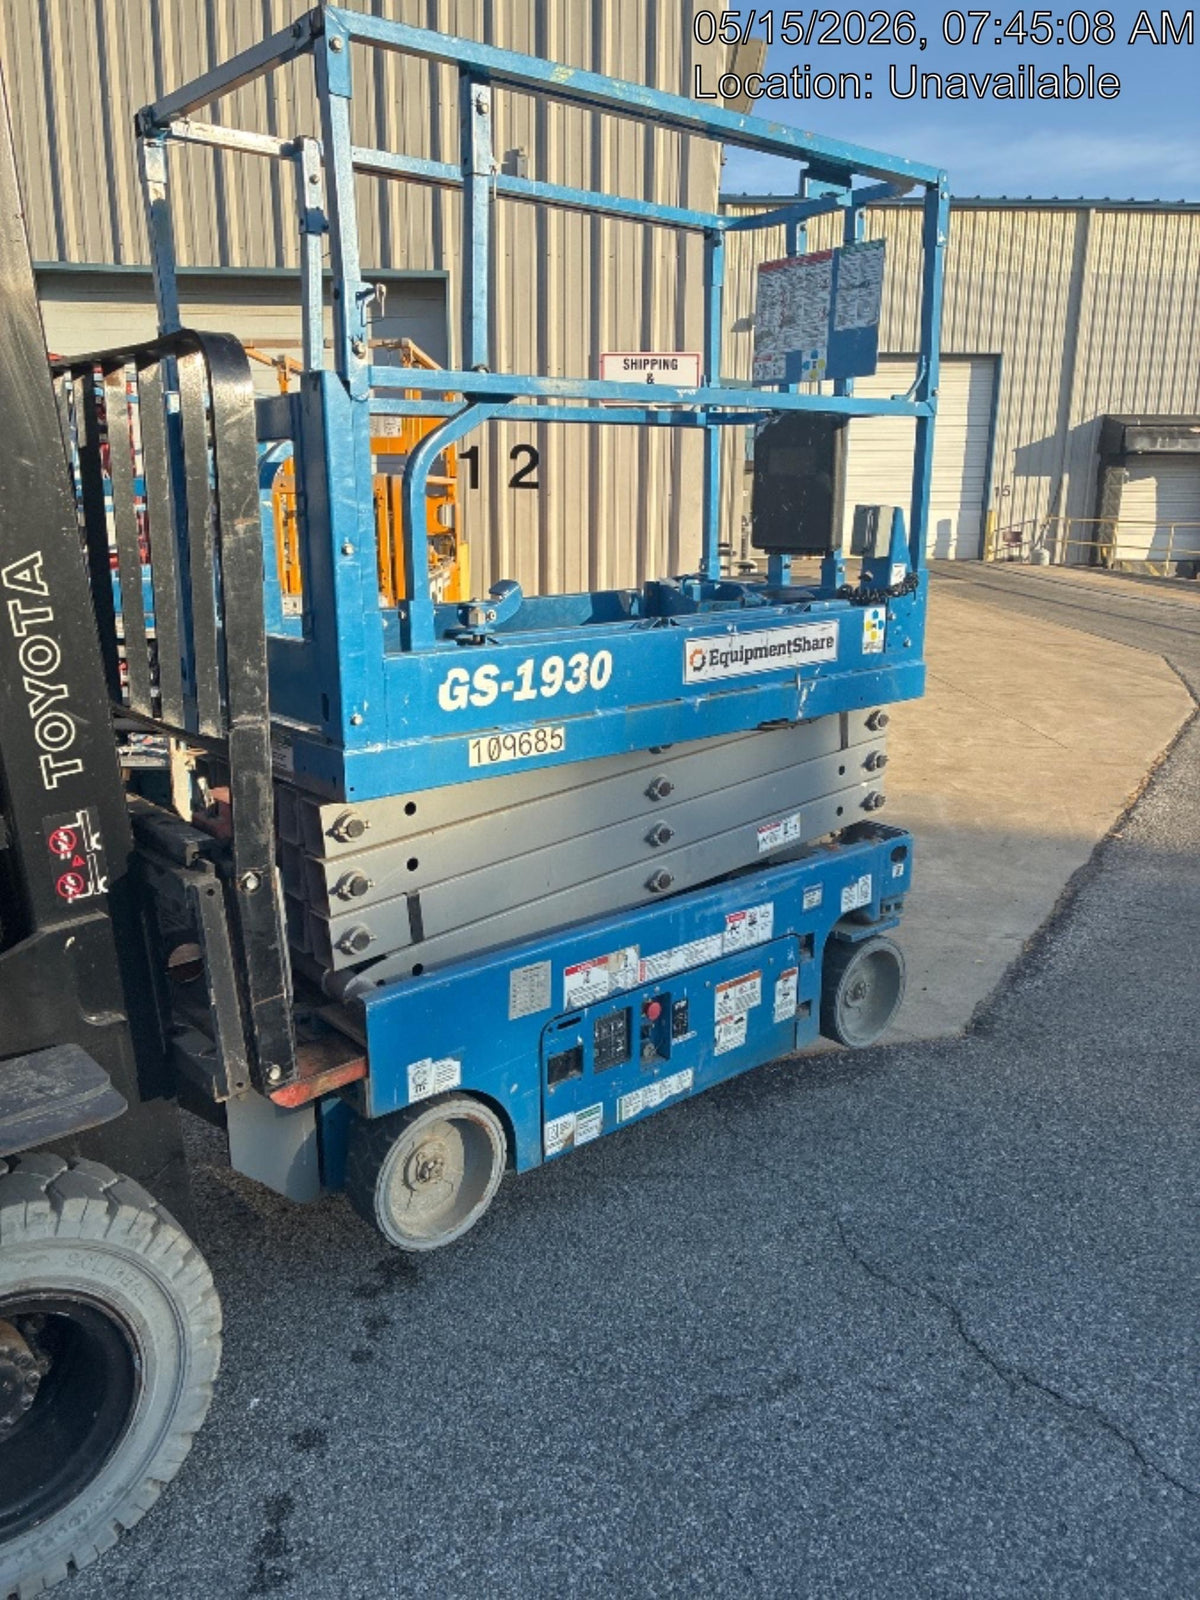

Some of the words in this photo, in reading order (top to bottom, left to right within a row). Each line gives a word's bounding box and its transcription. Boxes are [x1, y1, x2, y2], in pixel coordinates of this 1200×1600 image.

[623, 358, 679, 371] SHIPPING
[646, 372, 655, 385] &
[708, 635, 834, 668] EquipmentShare
[1, 551, 84, 790] TOYOTA
[438, 650, 613, 712] GS-1930
[472, 728, 563, 764] 109685
